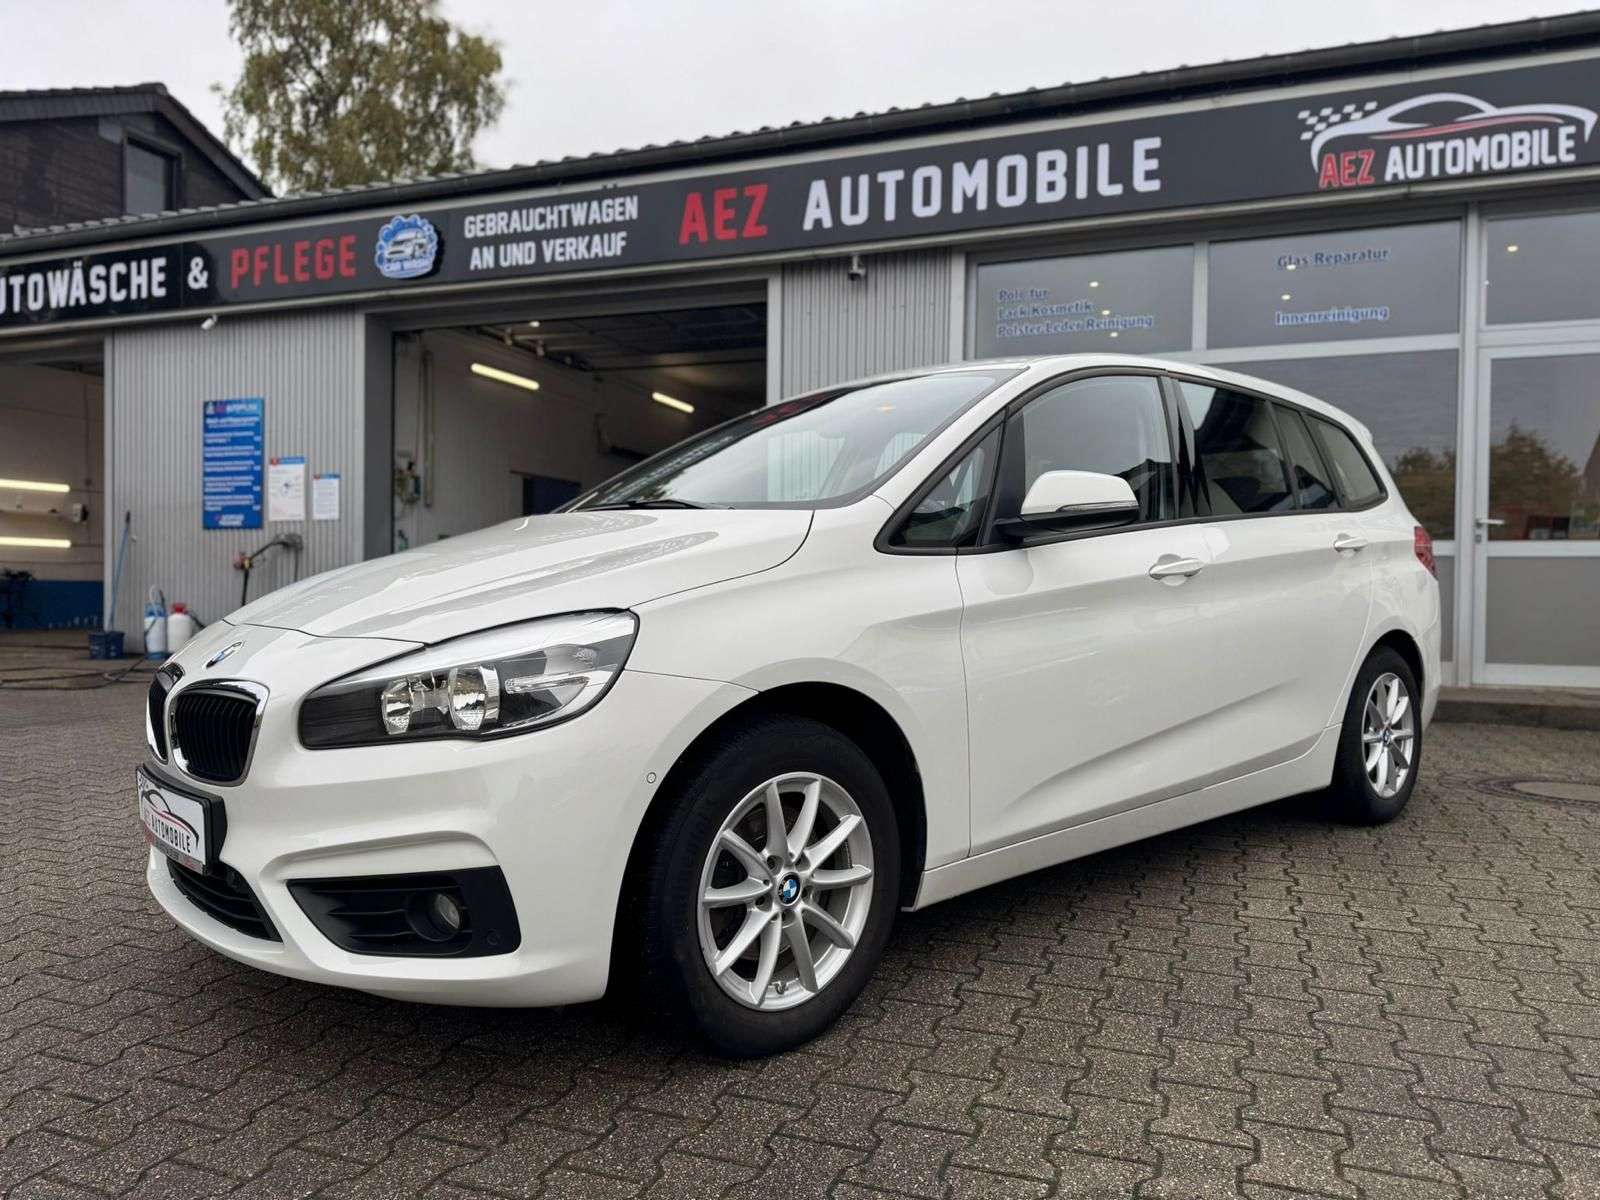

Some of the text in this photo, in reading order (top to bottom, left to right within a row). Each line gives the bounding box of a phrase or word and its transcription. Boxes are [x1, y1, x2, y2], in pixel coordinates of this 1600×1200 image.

[1319, 125, 1577, 188] AEZ AUTOMOBILE
[679, 136, 1163, 244] AEZ AUTOMOBILE
[464, 195, 639, 239] GEBRAUCHTWAGEN
[187, 256, 209, 290] &
[231, 234, 357, 289] PFLEGE
[469, 231, 628, 271] AN UND VERKAUF
[1314, 248, 1389, 265] Reparatur
